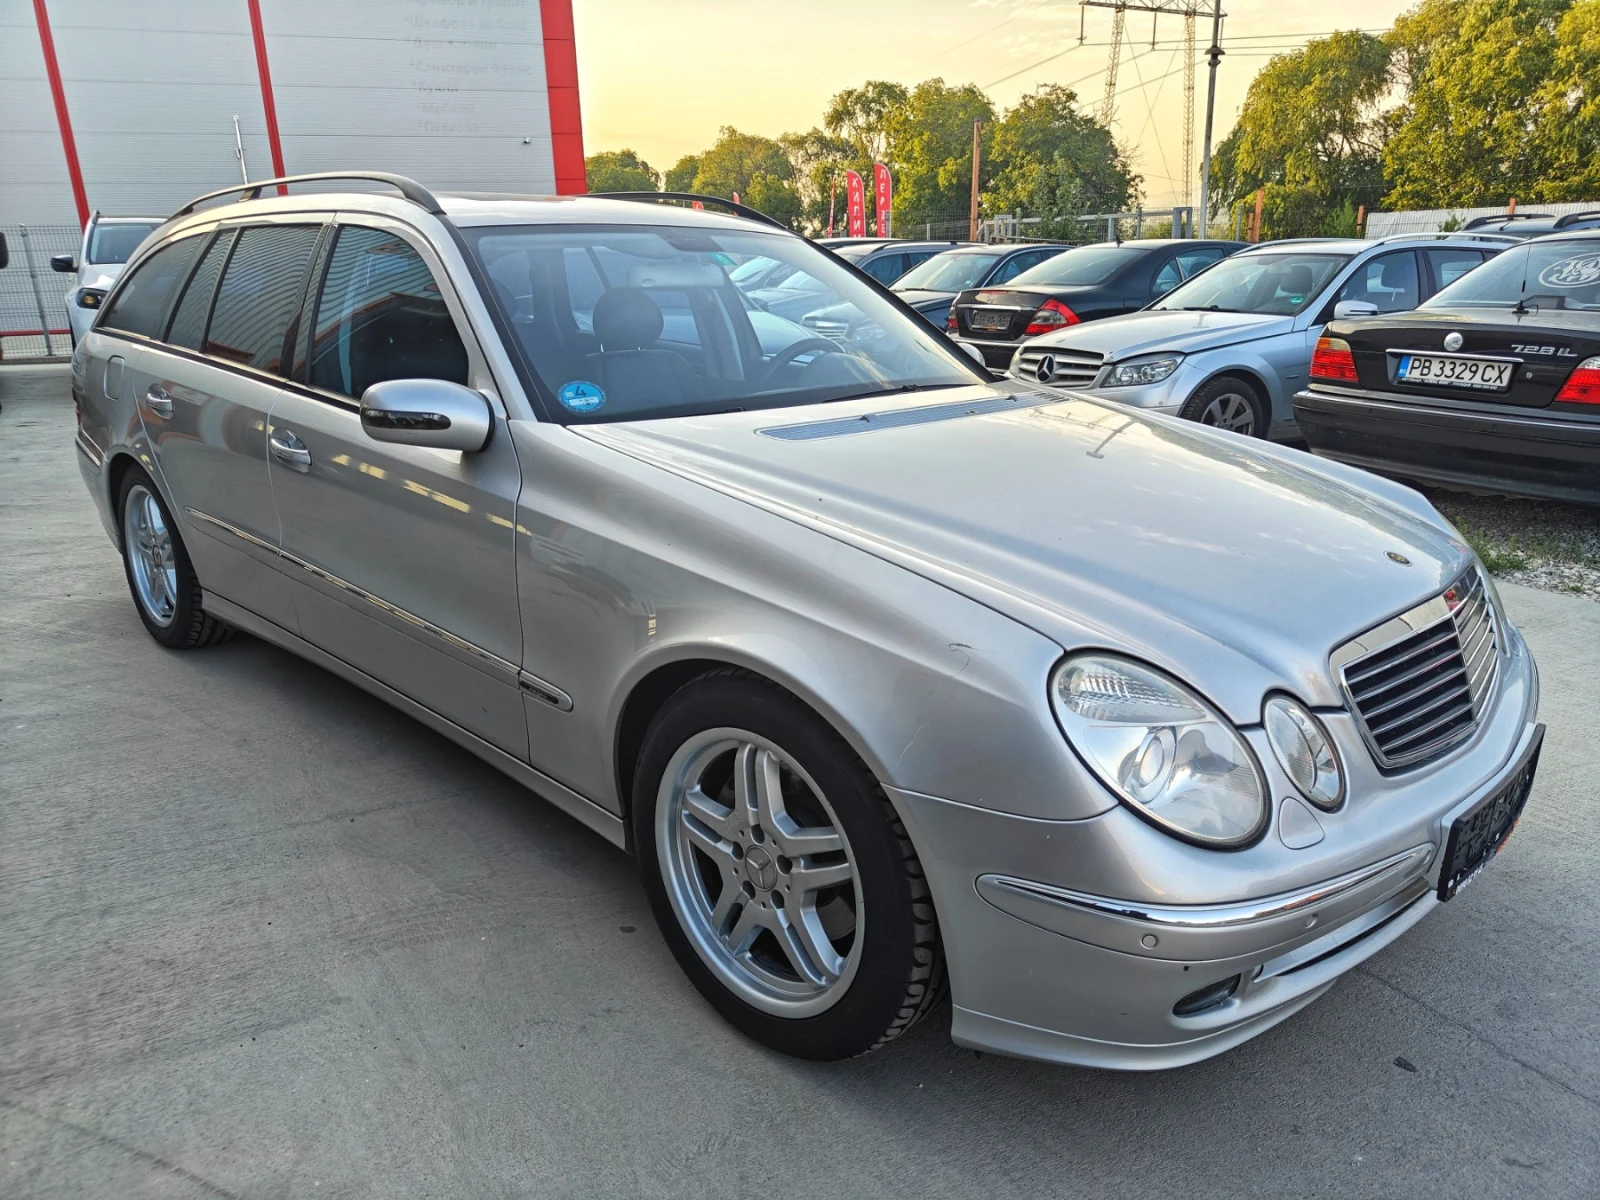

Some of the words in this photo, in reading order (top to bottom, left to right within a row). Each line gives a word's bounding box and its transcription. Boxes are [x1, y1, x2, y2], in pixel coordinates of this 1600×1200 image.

[1511, 344, 1555, 355] 728
[1409, 358, 1433, 377] PB
[1434, 360, 1479, 381] 3329
[1481, 364, 1509, 385] CX
[575, 385, 587, 397] 4
